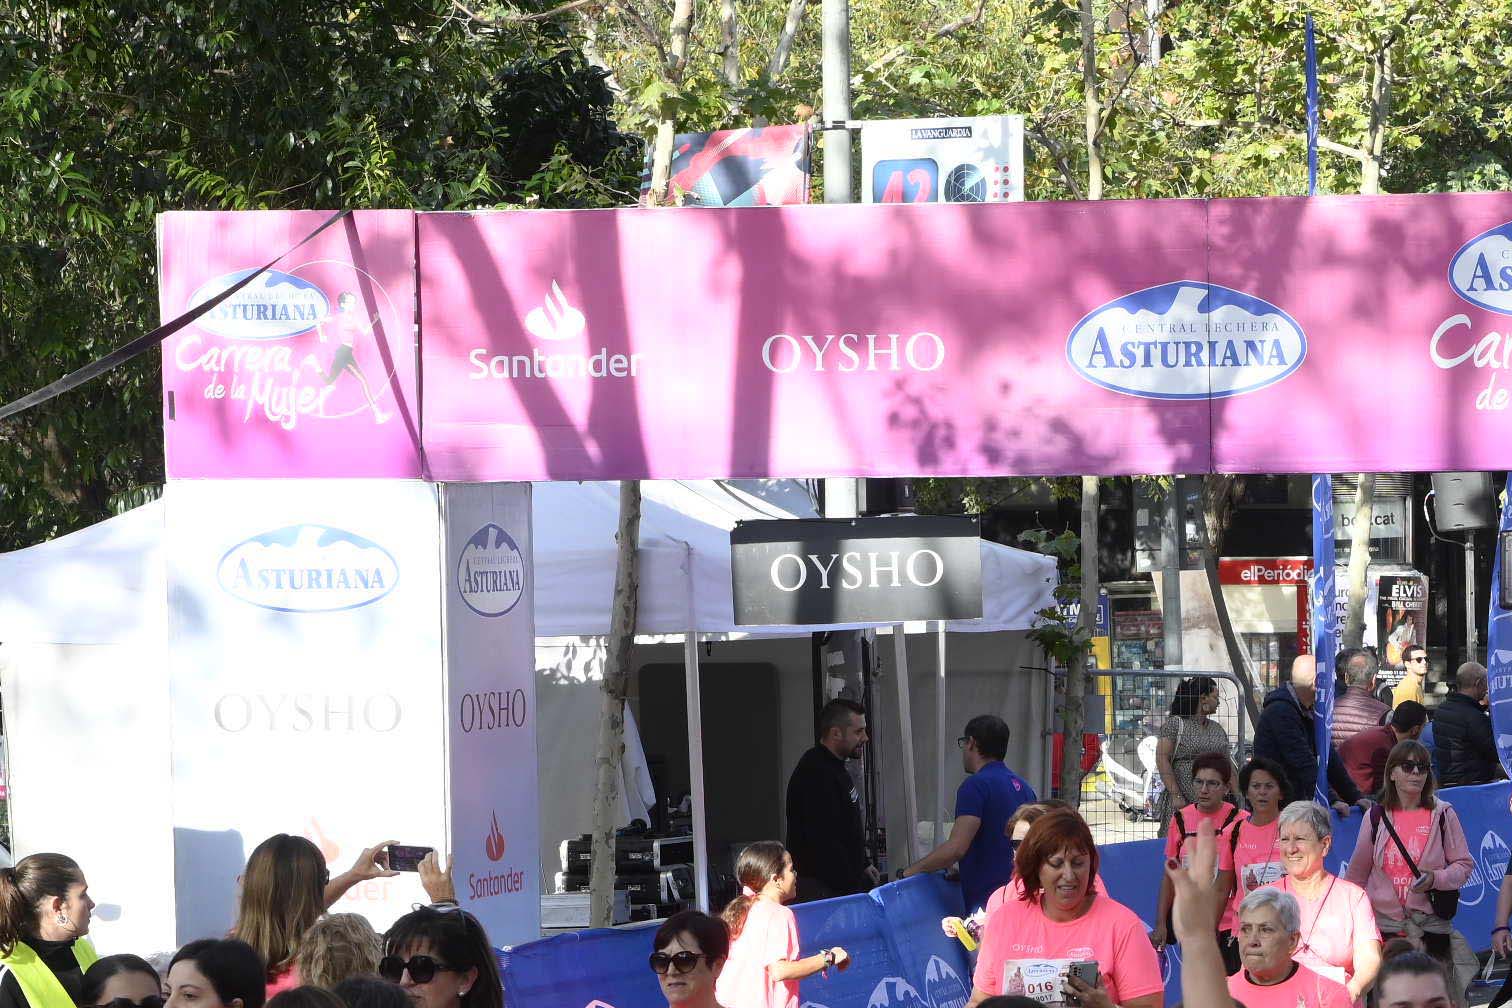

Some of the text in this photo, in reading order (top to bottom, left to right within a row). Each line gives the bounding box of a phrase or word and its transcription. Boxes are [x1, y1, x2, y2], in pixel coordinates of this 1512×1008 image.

[1123, 320, 1197, 334] CENTRAL
[468, 347, 642, 380] Santander
[761, 331, 946, 374] OYSHO
[1086, 327, 1288, 369] ASTURIANA
[1476, 373, 1509, 411] de
[232, 557, 386, 591] ASTURIANA
[463, 559, 521, 594] ASTURIANA
[769, 549, 944, 593] OYSHO
[1241, 564, 1315, 582] elPeriódi
[1391, 585, 1422, 597] ELVIS
[214, 692, 404, 734] OYSHO
[460, 688, 527, 734] OYSHO
[469, 868, 525, 901] Santander
[1028, 981, 1054, 994] 016
